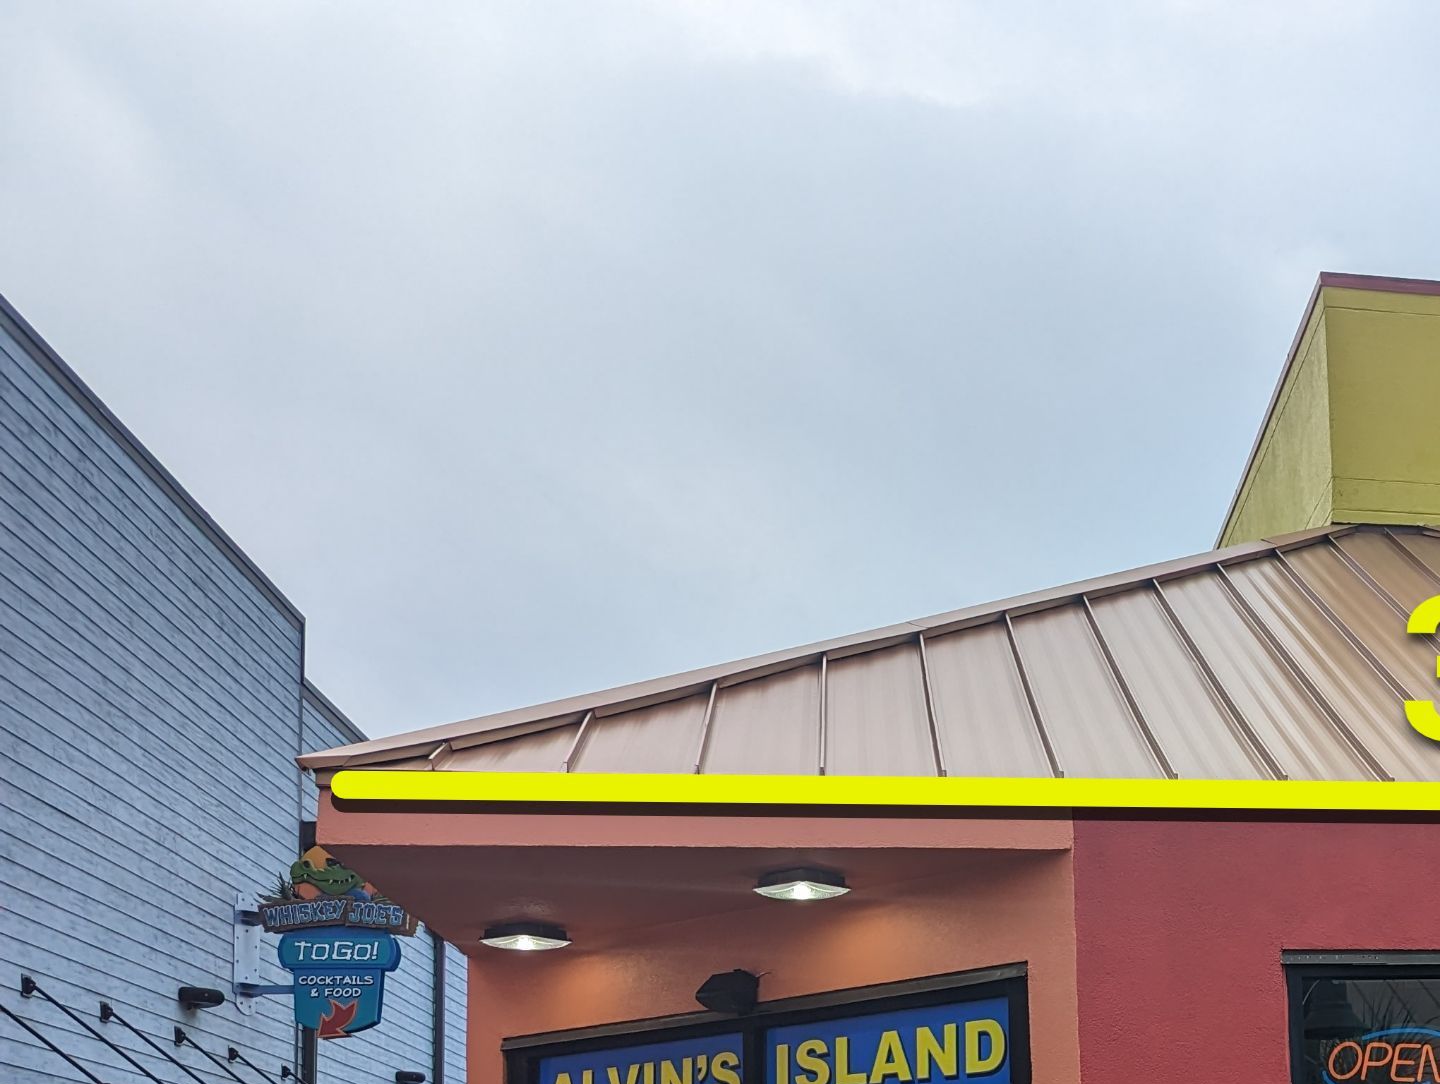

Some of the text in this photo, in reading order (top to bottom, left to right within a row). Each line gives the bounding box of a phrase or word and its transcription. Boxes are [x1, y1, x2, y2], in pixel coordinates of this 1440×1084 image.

[263, 900, 404, 927] WHISKEY JOE'S
[299, 975, 374, 986] COCKTAILS
[310, 987, 361, 997] & FOOD
